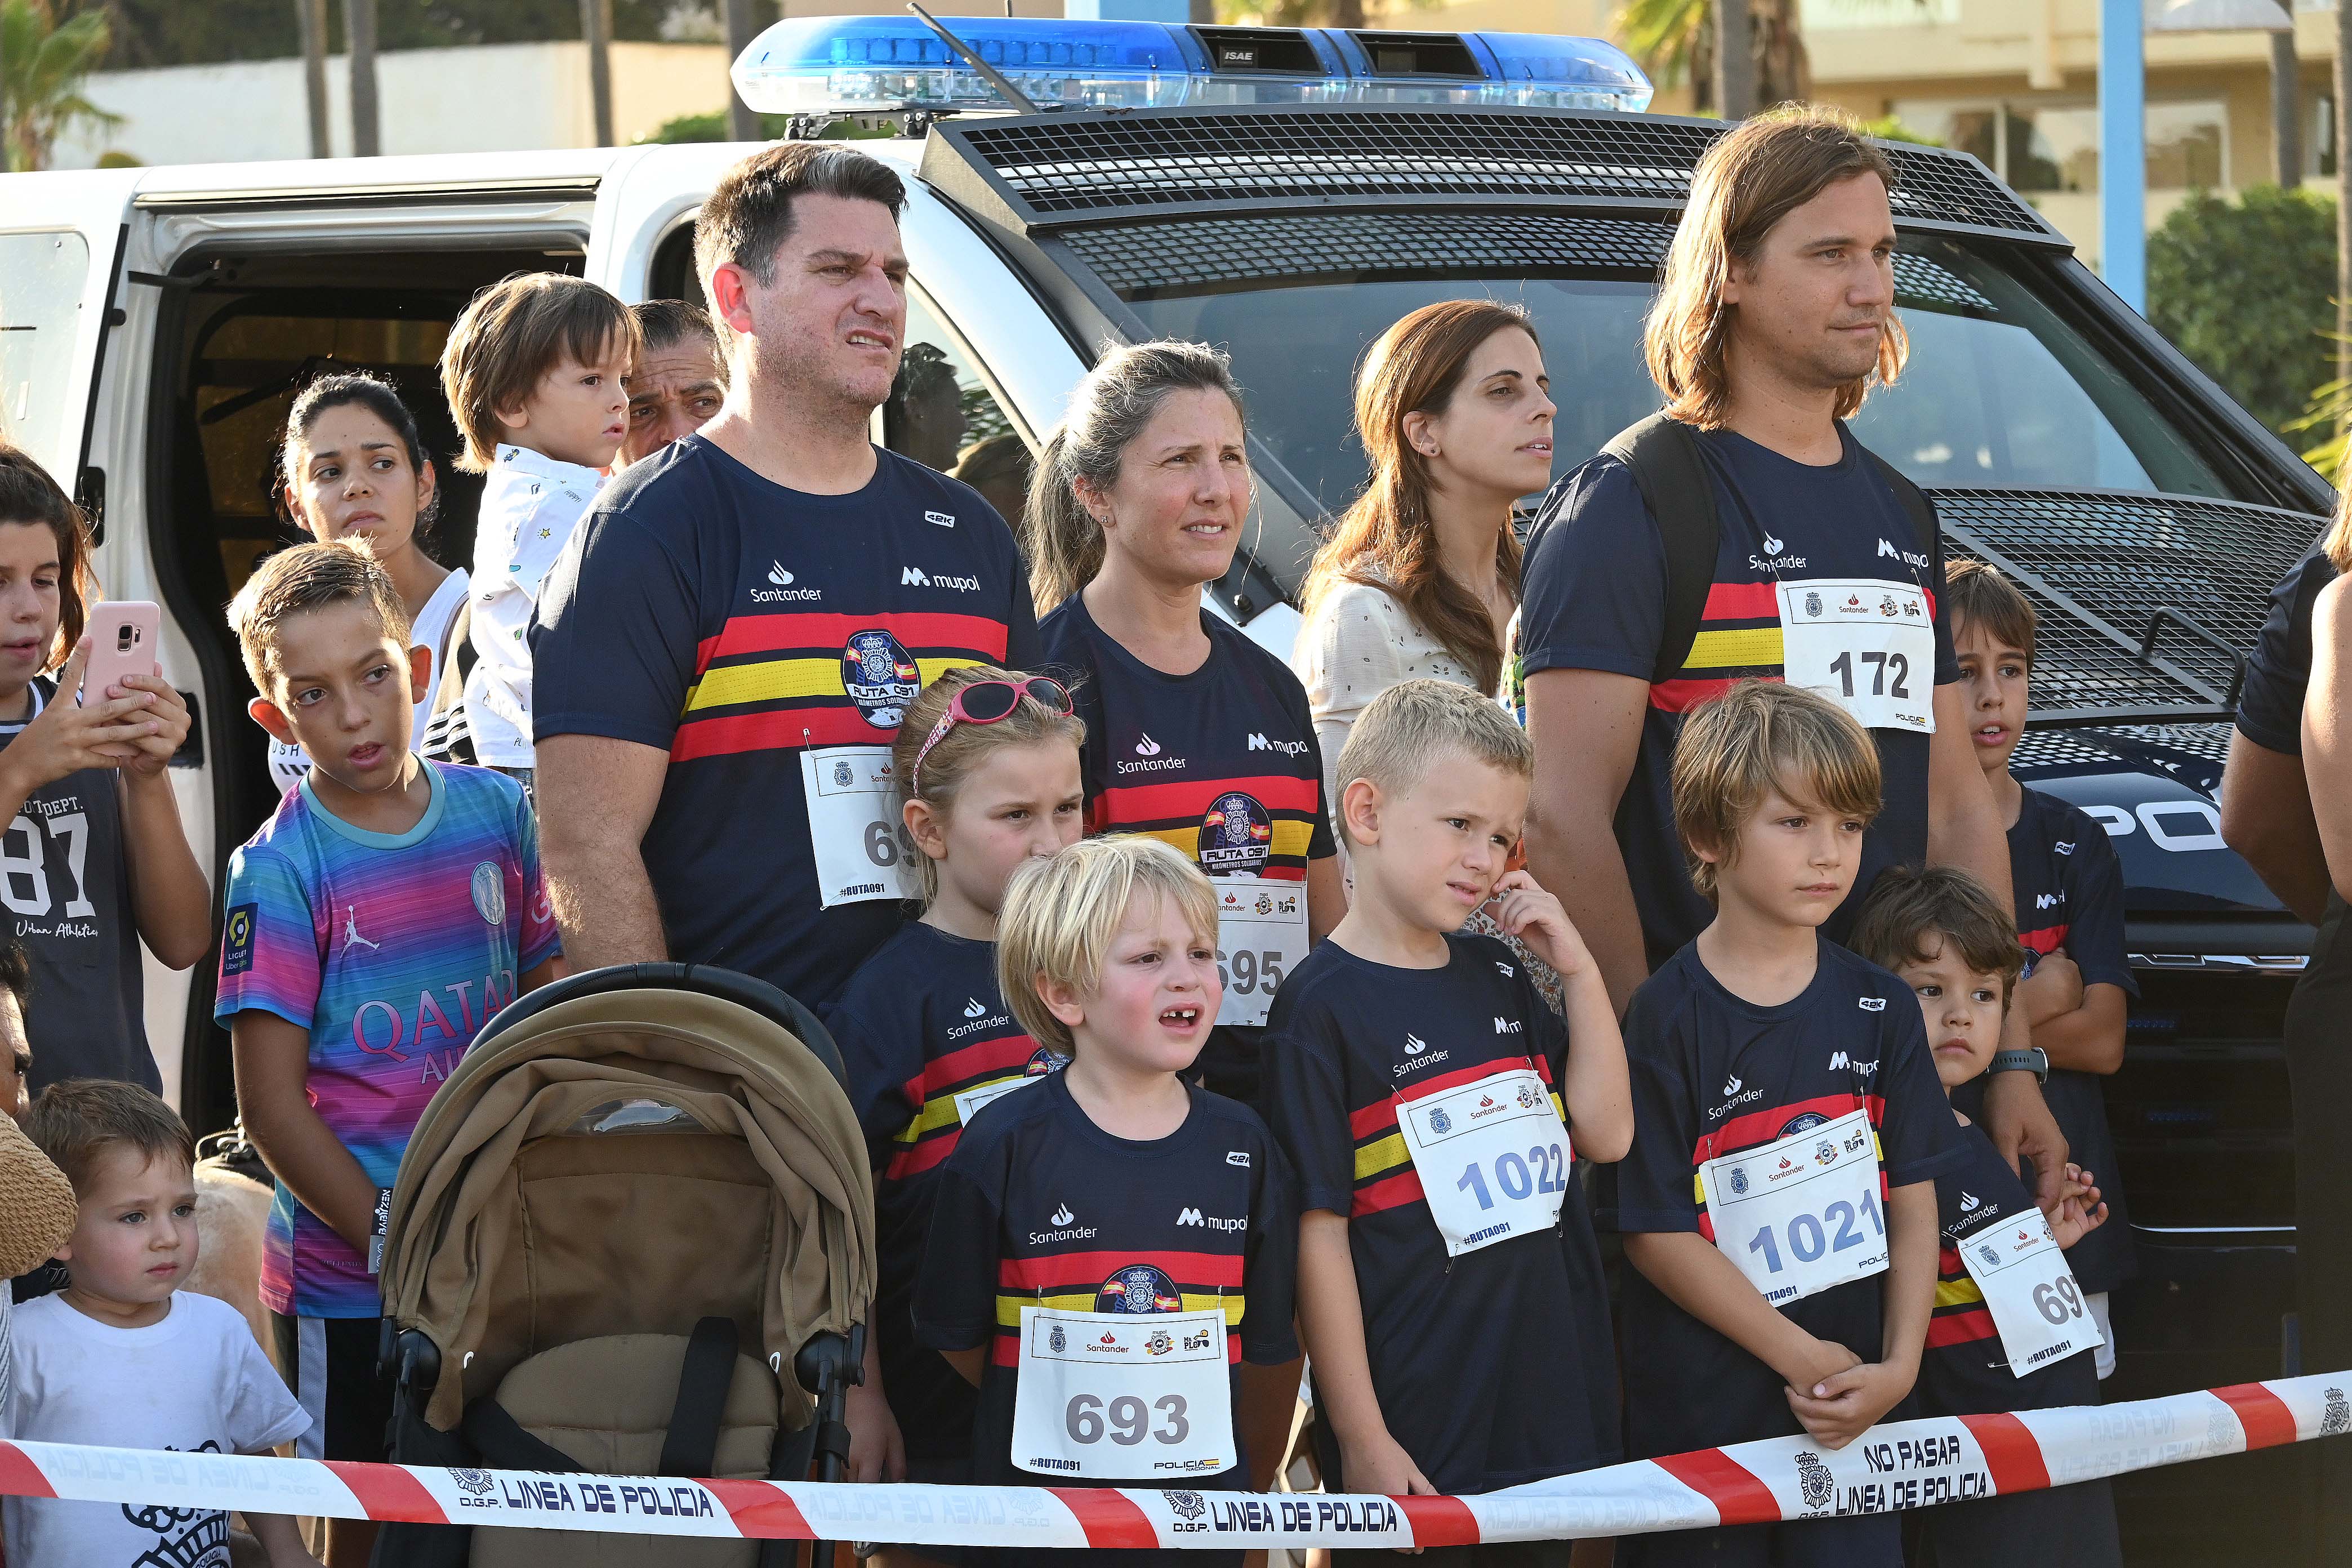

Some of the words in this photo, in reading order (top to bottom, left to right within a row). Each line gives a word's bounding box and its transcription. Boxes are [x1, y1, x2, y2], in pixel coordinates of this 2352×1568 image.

[1224, 51, 1253, 61] ISAE
[926, 513, 952, 525] 42K
[1749, 554, 1807, 573] Santander
[933, 573, 981, 593] mupol
[750, 586, 821, 603] Santander
[1829, 651, 1909, 699] 172
[853, 685, 889, 697] RUTA
[893, 685, 915, 696] 091
[1895, 713, 1920, 722] POLICIA
[1272, 740, 1310, 758] mupo
[1116, 757, 1186, 774] Santander
[871, 774, 898, 783] Santan
[42, 796, 84, 817] DEPT.
[1206, 849, 1244, 862] RUTA
[1247, 847, 1266, 857] 091
[0, 812, 96, 918] 87
[1211, 861, 1241, 870] KILÓMETROS
[839, 883, 885, 898] #RUTA091
[16, 919, 52, 937] Urban
[352, 969, 514, 1063] QATAR
[947, 1014, 1010, 1040] Santander
[1393, 1049, 1450, 1078] Santander
[1470, 1104, 1508, 1120] Santander
[1708, 1087, 1765, 1120] Santander
[1816, 1138, 1828, 1147] mupol
[1456, 1143, 1566, 1211] 1022
[1769, 1164, 1805, 1182] Santander
[1948, 1202, 1999, 1235] Santander
[1028, 1227, 1097, 1245] Santander
[1463, 1221, 1511, 1245] #RUTA091
[1748, 1188, 1884, 1274] 1021
[2014, 1237, 2039, 1252] Santander
[1858, 1251, 1888, 1269] POLIC
[1762, 1285, 1798, 1302] UTA091
[1086, 1344, 1129, 1353] Santander
[2026, 1339, 2072, 1365] #RUTA091
[1066, 1393, 1190, 1446] 693
[1864, 1443, 1895, 1473] NO
[1897, 1435, 1961, 1471] PASAR
[1029, 1458, 1080, 1471] #RUTA091
[1154, 1459, 1205, 1469] POLICIA
[459, 1496, 501, 1508] D.G.P.
[500, 1479, 576, 1511] LINEA
[577, 1483, 617, 1513] DE
[618, 1485, 714, 1517] POLICIA
[1835, 1483, 1885, 1516] LINEA
[1892, 1480, 1917, 1510] DE
[1923, 1472, 1986, 1507] POLICIA
[1211, 1502, 1275, 1532] LINEA
[1280, 1502, 1312, 1532] DE
[1318, 1502, 1397, 1532] POLICIA
[1173, 1523, 1210, 1533] D.G.P.
